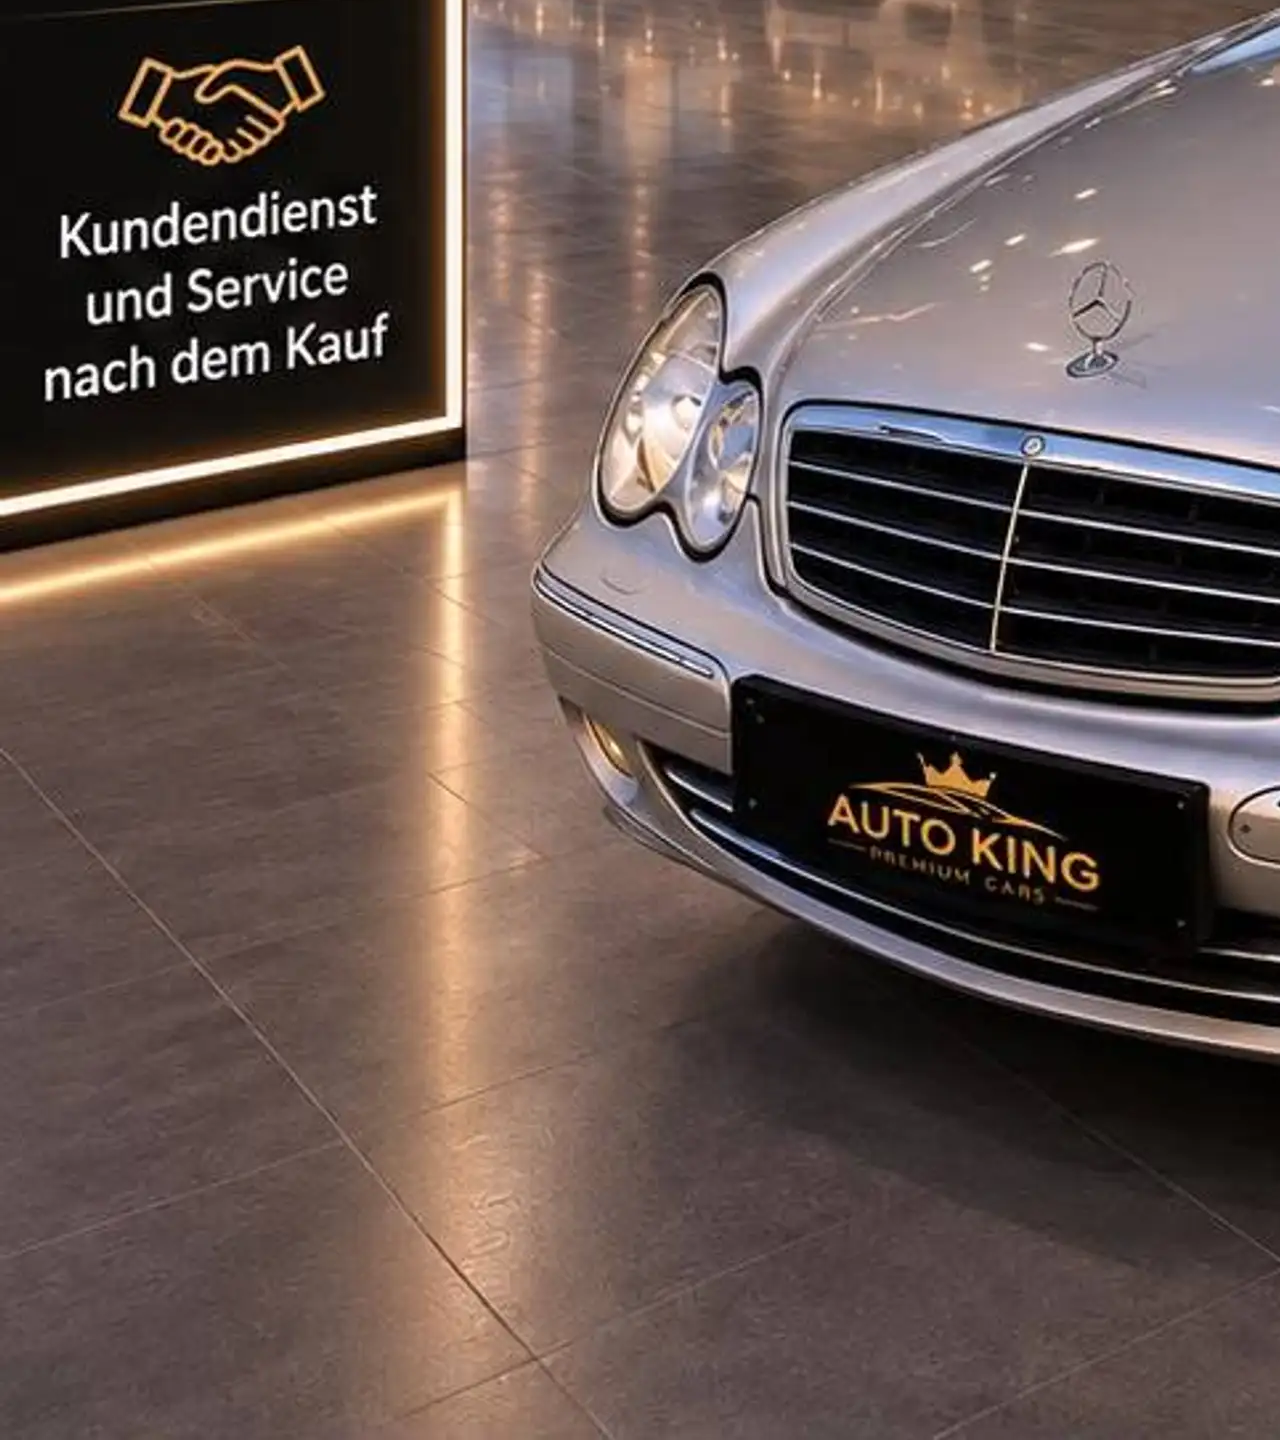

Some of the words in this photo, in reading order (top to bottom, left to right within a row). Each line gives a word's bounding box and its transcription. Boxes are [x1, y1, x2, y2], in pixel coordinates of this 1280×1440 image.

[60, 185, 378, 259] Kundendienst
[87, 272, 173, 325] und
[187, 257, 349, 311] Service
[44, 345, 157, 402] nach
[171, 337, 271, 384] dem
[285, 311, 391, 370] Kauf
[827, 793, 956, 856] AUTO
[971, 827, 1100, 892] KING
[869, 845, 971, 886] PREMIUM
[984, 875, 1046, 906] CARS
